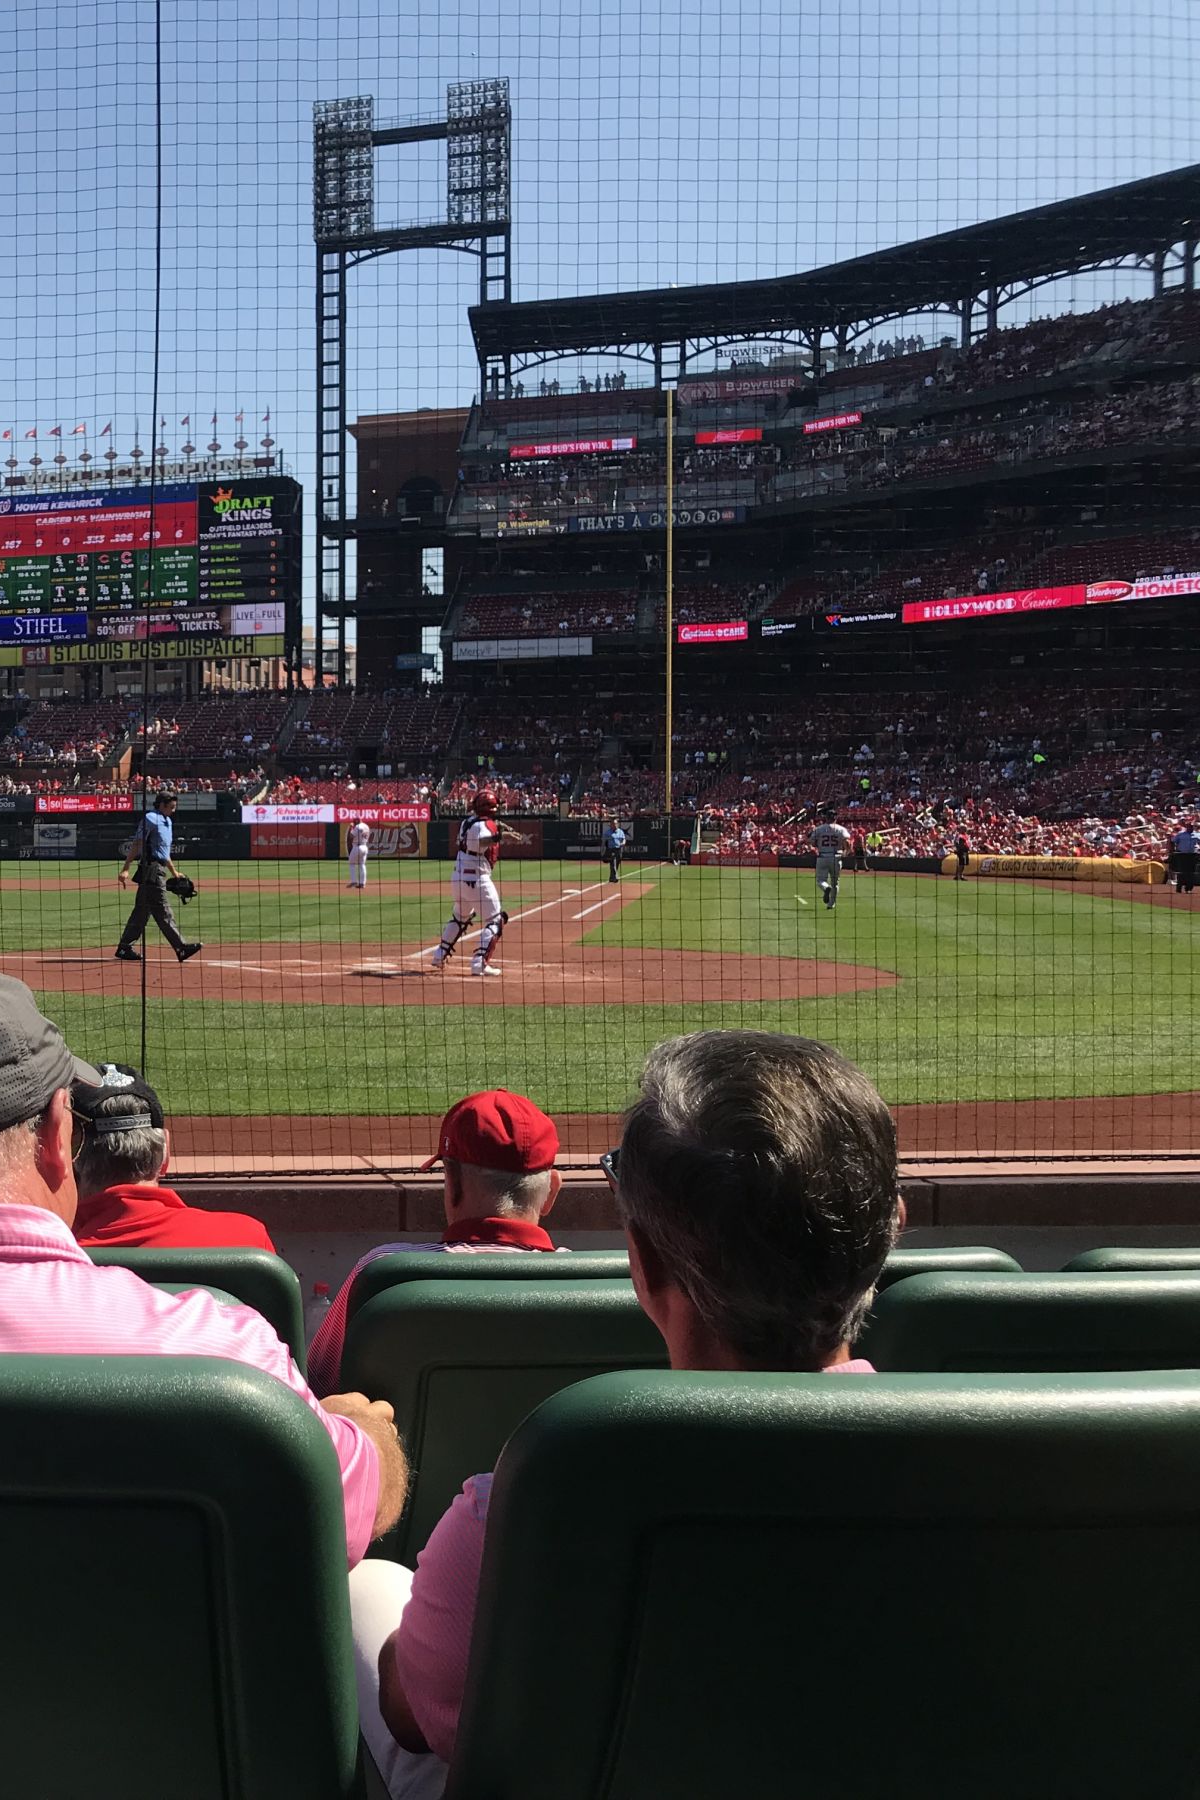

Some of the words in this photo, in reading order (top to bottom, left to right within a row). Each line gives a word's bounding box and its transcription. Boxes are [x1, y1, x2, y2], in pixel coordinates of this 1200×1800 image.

[715, 346, 784, 357] BUDWEISER
[726, 378, 795, 392] BUDWEISER
[24, 468, 106, 487] WORLD
[115, 458, 256, 480] CHAMPIONS
[16, 500, 49, 512] HOWIE
[50, 497, 103, 510] KENDRICK
[214, 496, 274, 513] DRAFT
[221, 508, 273, 522] KINGS
[578, 515, 624, 530] THAT'S
[632, 514, 642, 527] A
[262, 609, 282, 619] FULL
[923, 596, 1017, 618] HOLLYWOOD
[237, 611, 254, 620] LIVE
[868, 612, 897, 621] Technology
[13, 616, 68, 635] STIFEL
[96, 625, 116, 635] 50%
[118, 624, 134, 634] OFF
[723, 626, 745, 637] CARE
[53, 642, 77, 662] ST.
[79, 641, 123, 660] LOUIS
[128, 635, 254, 659] POST-DISPATCH
[338, 807, 379, 820] DRURY
[382, 808, 429, 820] HOTELS
[821, 834, 839, 847] 25
